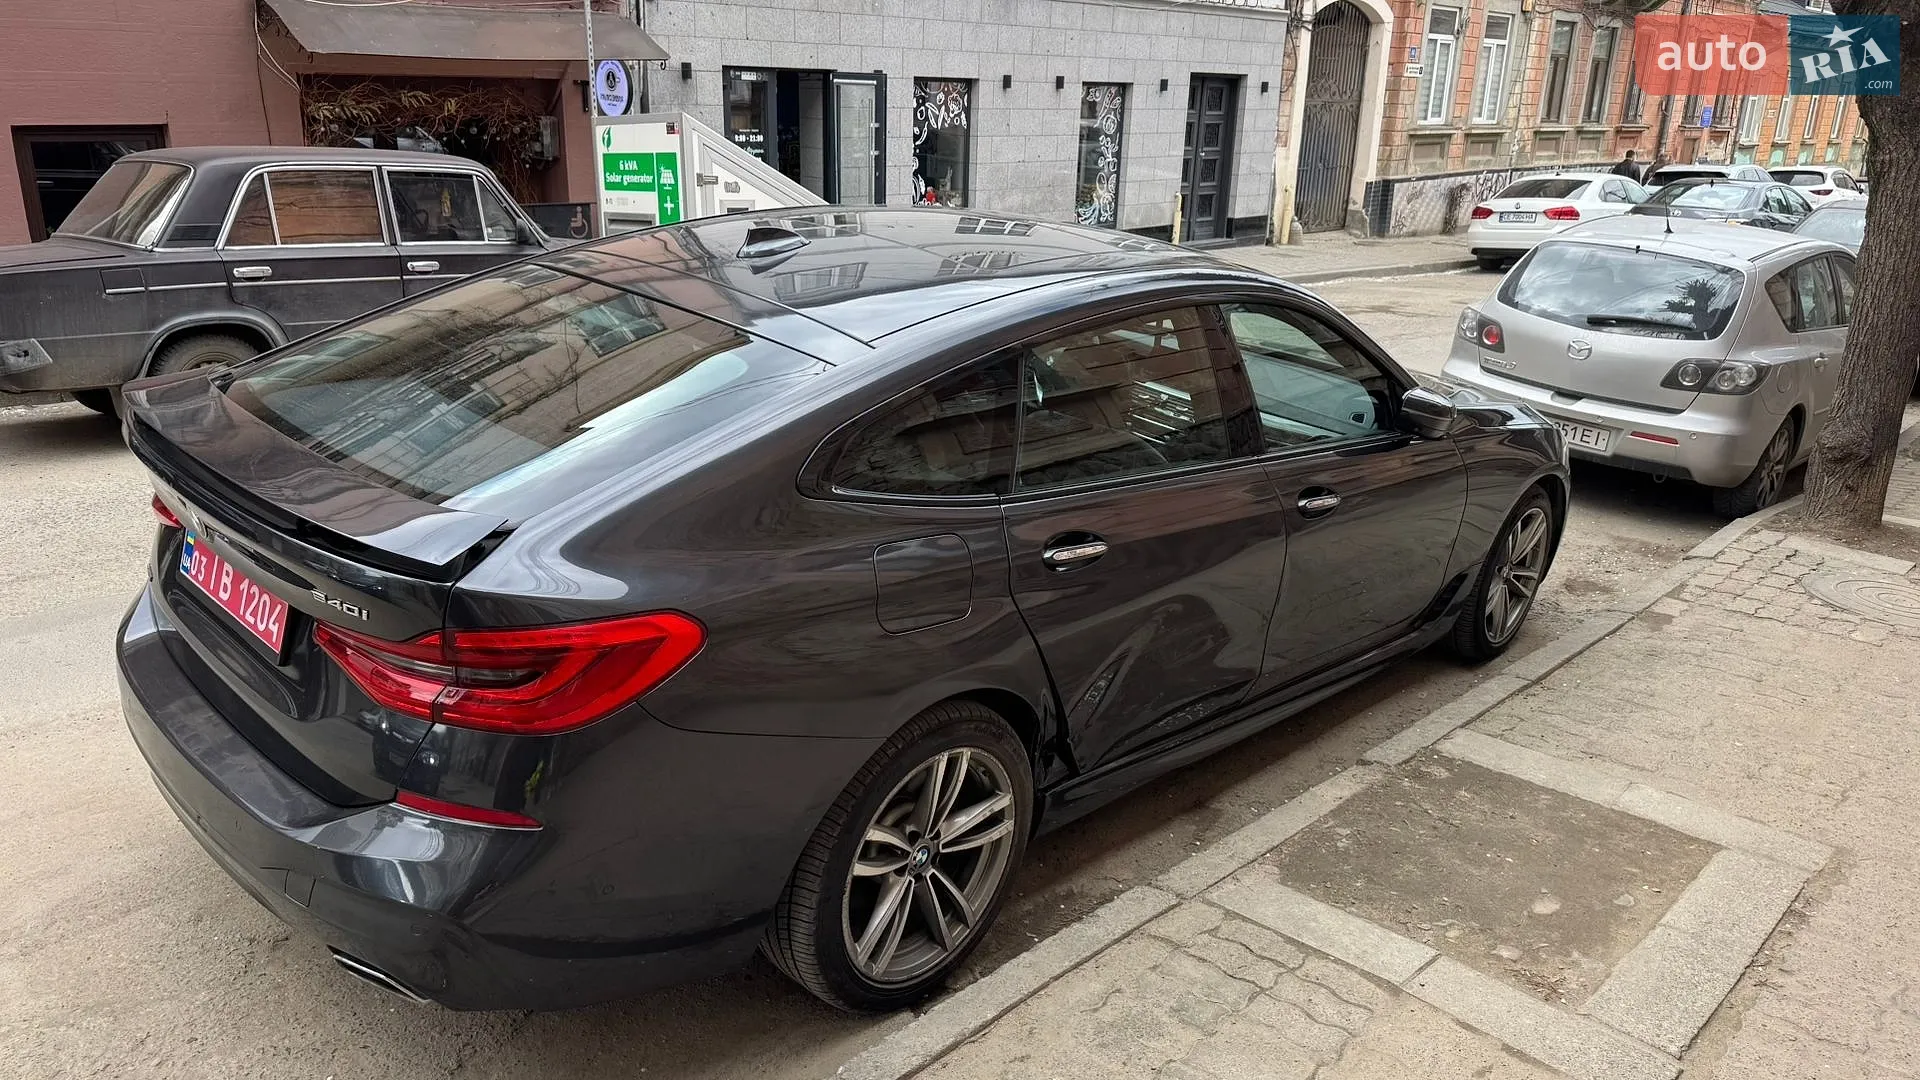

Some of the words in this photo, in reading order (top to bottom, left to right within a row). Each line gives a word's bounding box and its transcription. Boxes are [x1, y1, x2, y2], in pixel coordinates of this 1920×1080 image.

[618, 160, 624, 171] 6
[624, 160, 638, 171] kVA
[605, 172, 622, 183] Solar
[623, 173, 654, 186] generator
[182, 552, 191, 570] UA
[190, 550, 208, 582] 03
[209, 554, 234, 601] IB
[239, 577, 283, 643] 1204
